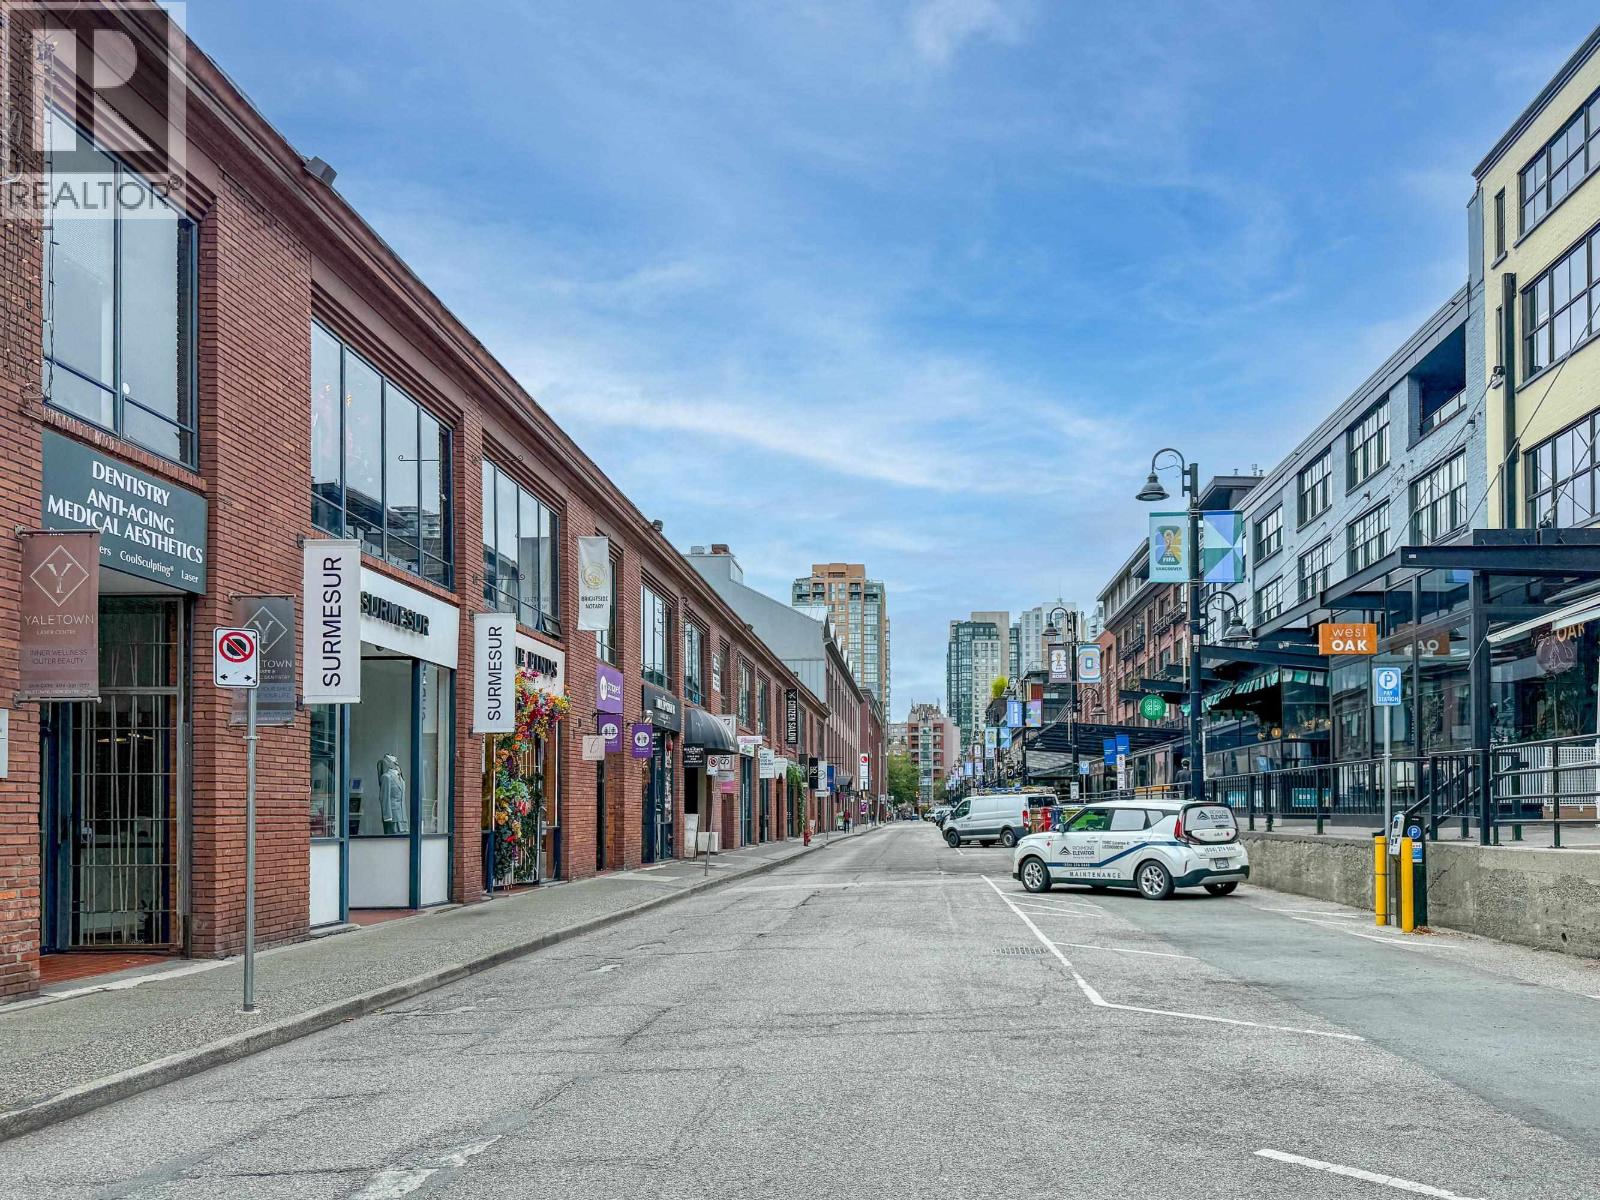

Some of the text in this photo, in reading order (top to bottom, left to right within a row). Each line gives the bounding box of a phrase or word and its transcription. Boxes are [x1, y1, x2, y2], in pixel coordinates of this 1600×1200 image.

[92, 460, 170, 507] DENTISTRY
[87, 488, 174, 534] ANTI-AGING
[48, 494, 203, 564] MEDICAL AESTHETICS
[181, 570, 199, 583] Laser
[24, 614, 94, 625] YALETOWN
[322, 556, 343, 688] SURMESUR
[360, 590, 430, 636] SURMESUR
[57, 657, 85, 665] BEAUTY
[1331, 639, 1368, 651] OAK
[261, 659, 293, 668] TOWN
[487, 626, 503, 721] SURMESUR
[787, 700, 797, 722] CITIZEN
